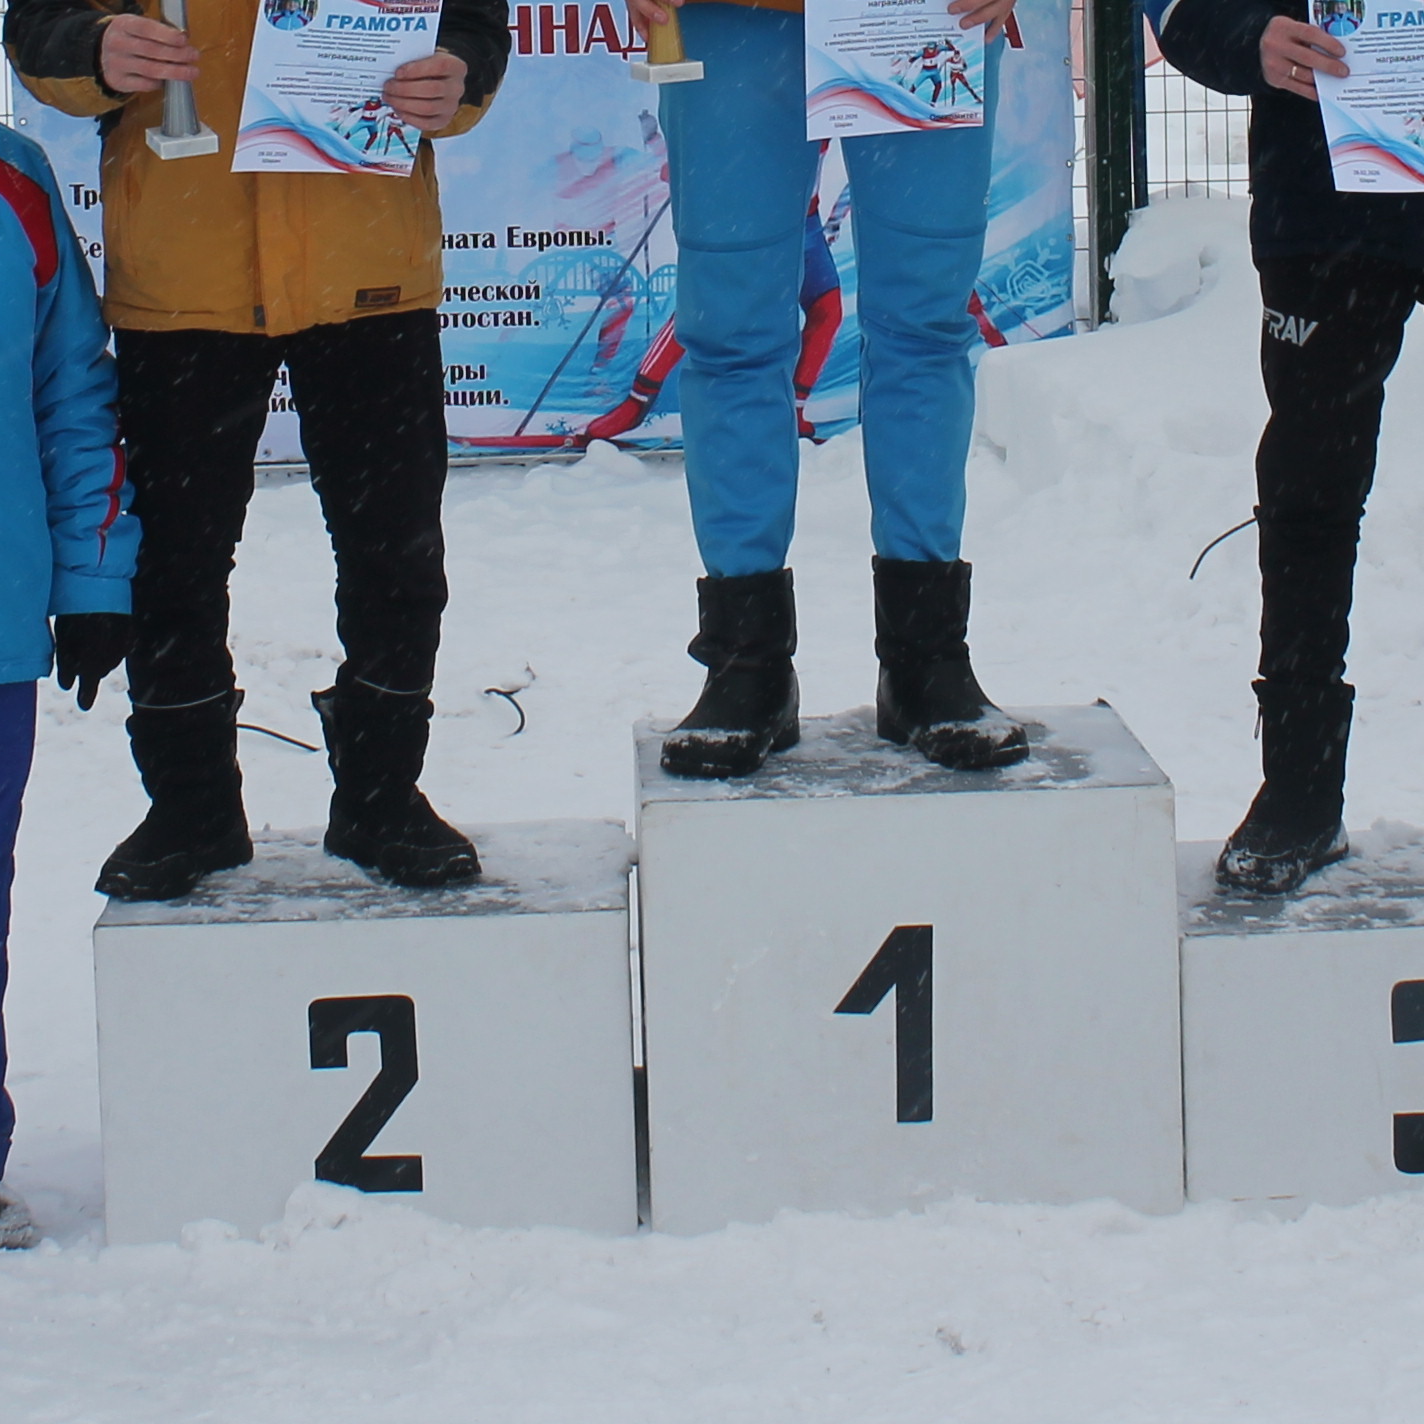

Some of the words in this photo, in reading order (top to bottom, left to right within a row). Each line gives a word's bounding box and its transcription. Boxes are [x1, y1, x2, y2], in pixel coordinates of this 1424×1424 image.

[326, 14, 428, 32] ГРАМОТА
[69, 184, 103, 211] Тр
[506, 226, 613, 253] Европы.
[832, 924, 935, 1125] 1
[308, 994, 425, 1194] 2
